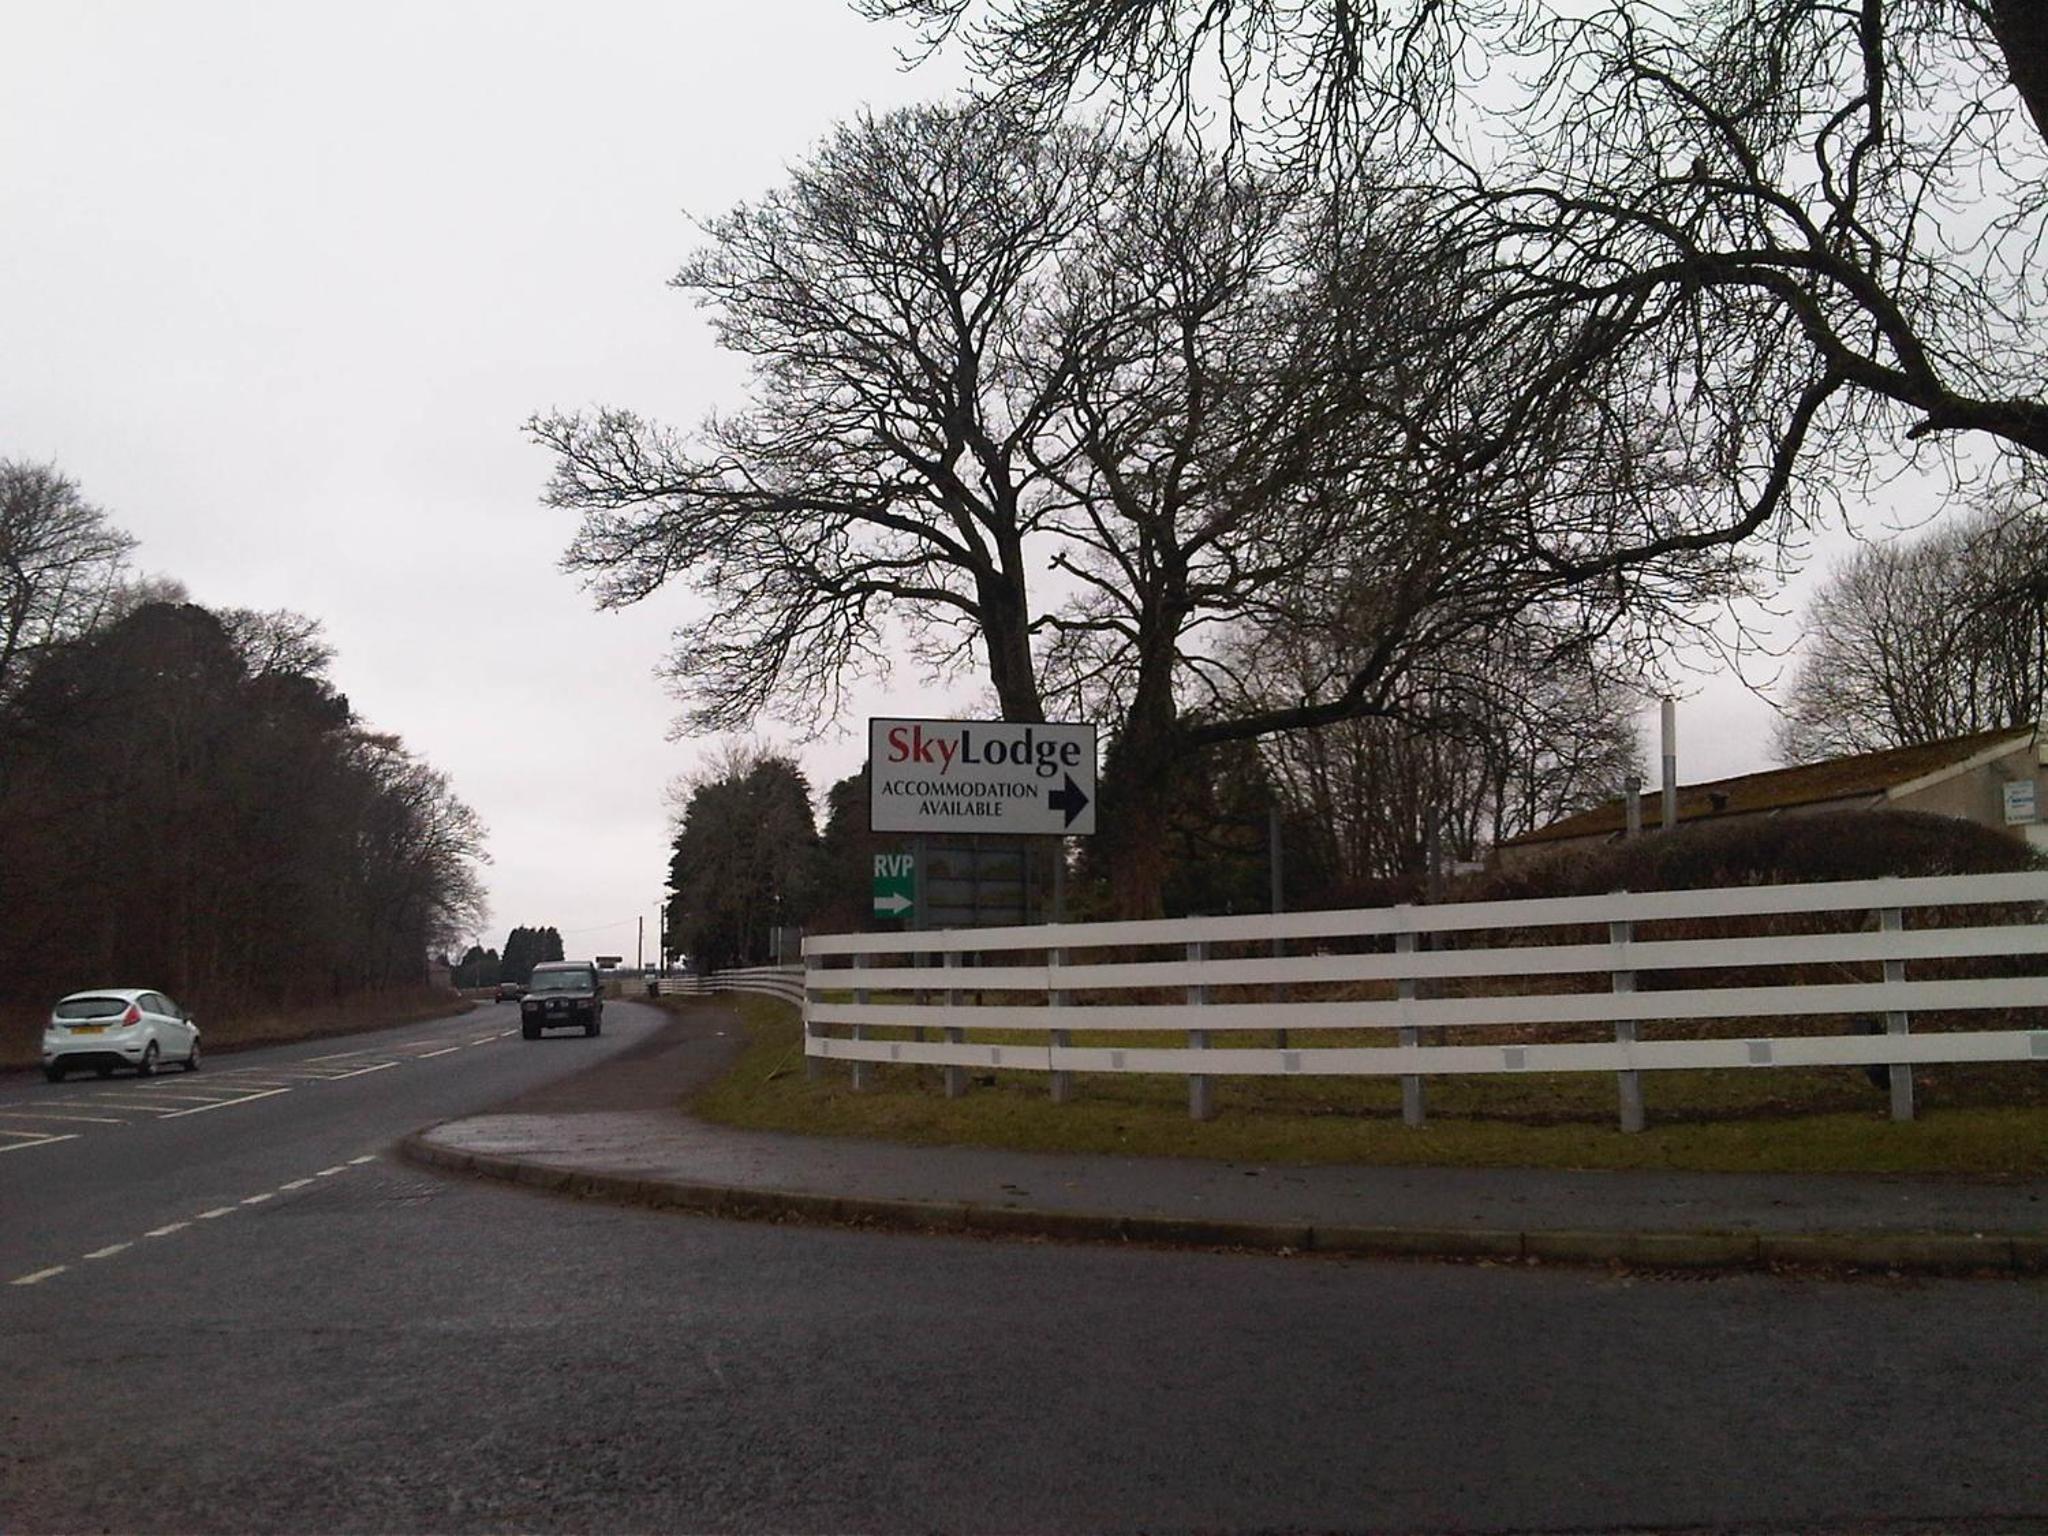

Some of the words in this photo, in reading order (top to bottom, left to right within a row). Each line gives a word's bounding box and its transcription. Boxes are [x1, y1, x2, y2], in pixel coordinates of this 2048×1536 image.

[888, 725, 1081, 778] SkyLodge
[882, 780, 1038, 798] ACCOMMODATION
[919, 800, 1002, 817] AVAILABLE
[874, 854, 914, 877] RVP
